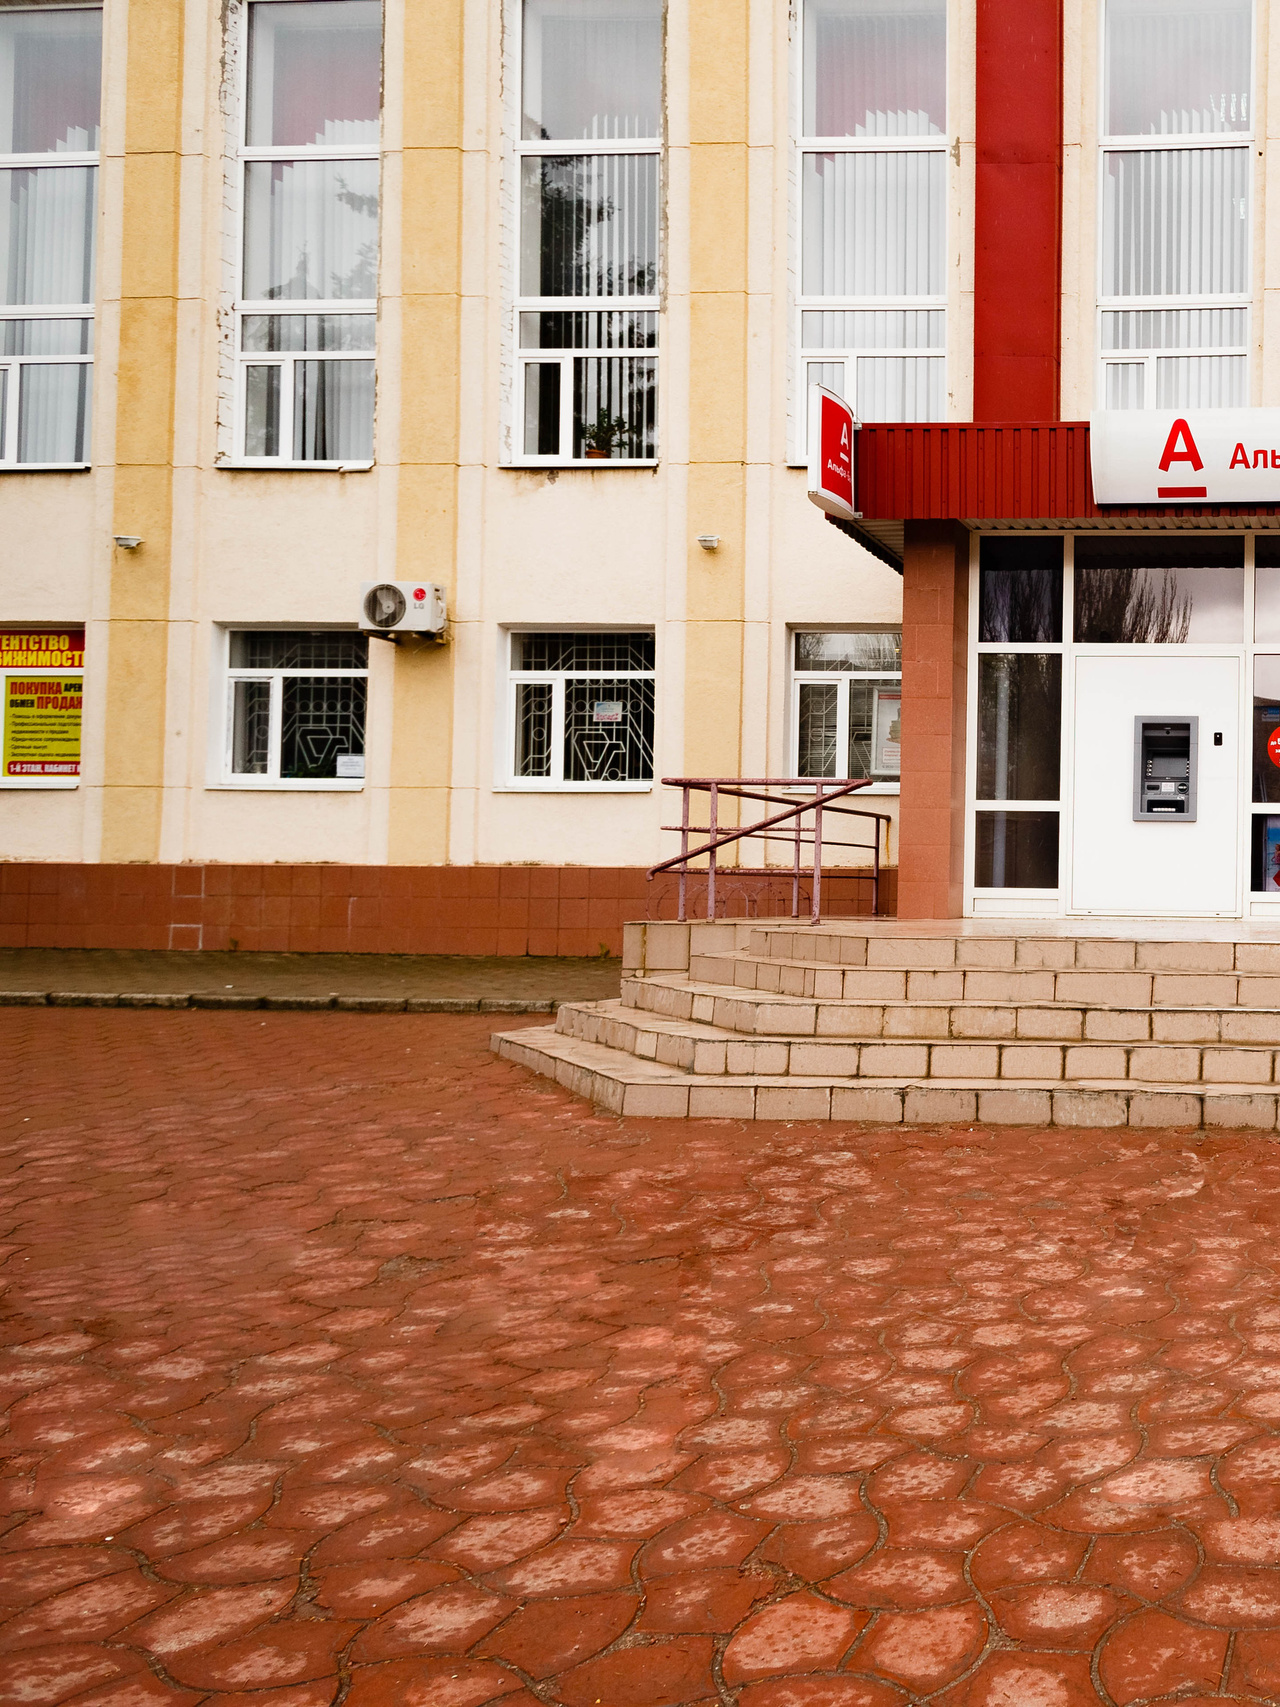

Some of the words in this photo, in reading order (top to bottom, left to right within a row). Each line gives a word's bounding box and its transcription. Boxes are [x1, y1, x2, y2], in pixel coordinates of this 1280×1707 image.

[0, 634, 69, 650] ЕНТСТВО
[0, 650, 84, 667] ИЖИМОСТ
[10, 682, 62, 695] ПОКУПКА
